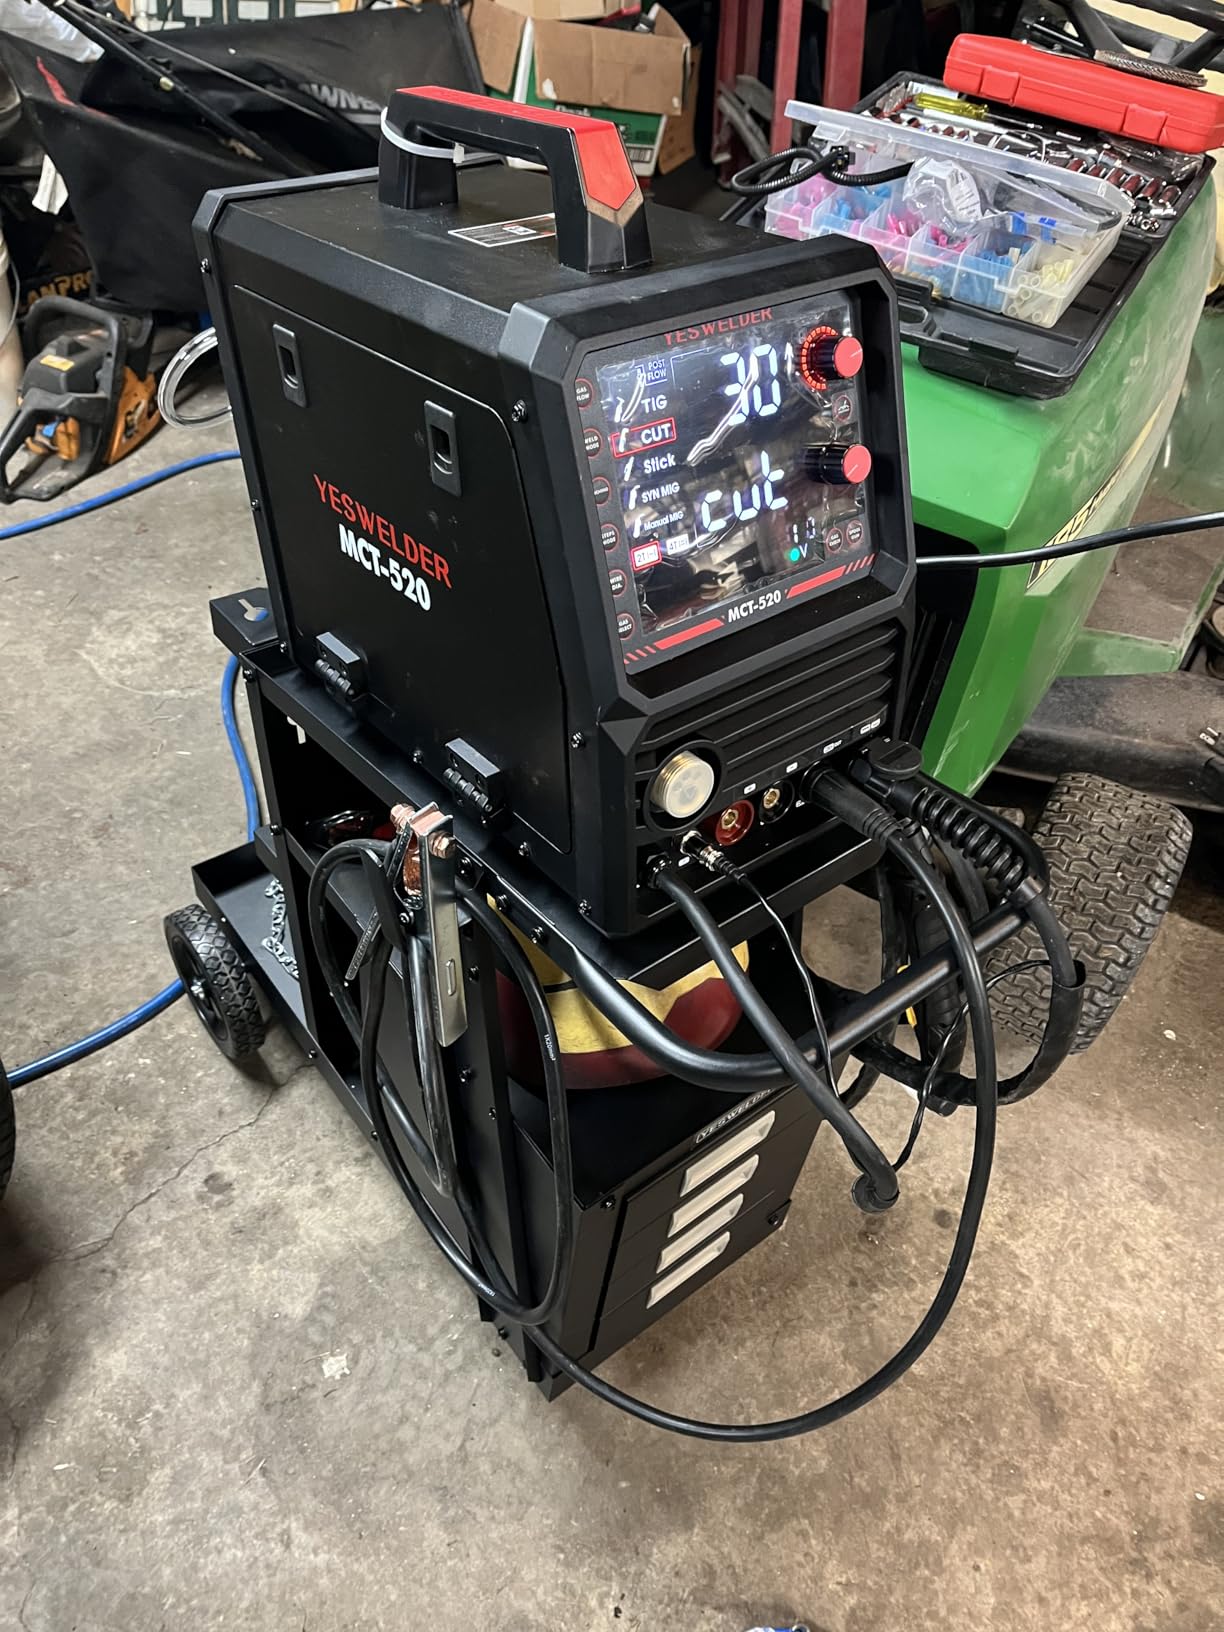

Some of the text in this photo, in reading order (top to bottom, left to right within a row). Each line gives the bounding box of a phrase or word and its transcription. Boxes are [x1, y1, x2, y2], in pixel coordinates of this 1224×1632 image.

[664, 307, 773, 346] YESWELDER
[647, 368, 667, 381] FLOW
[648, 359, 665, 371] POST
[720, 344, 781, 426] 30
[641, 394, 667, 413] TIG
[641, 423, 671, 444] CUT
[644, 453, 676, 474] Stick
[641, 481, 680, 503] SYN MIG
[313, 473, 452, 589] YESWELDER
[644, 511, 684, 531] Manual MIG
[799, 543, 808, 558] V
[339, 523, 431, 611] MCT-520
[728, 590, 781, 623] MCT-520
